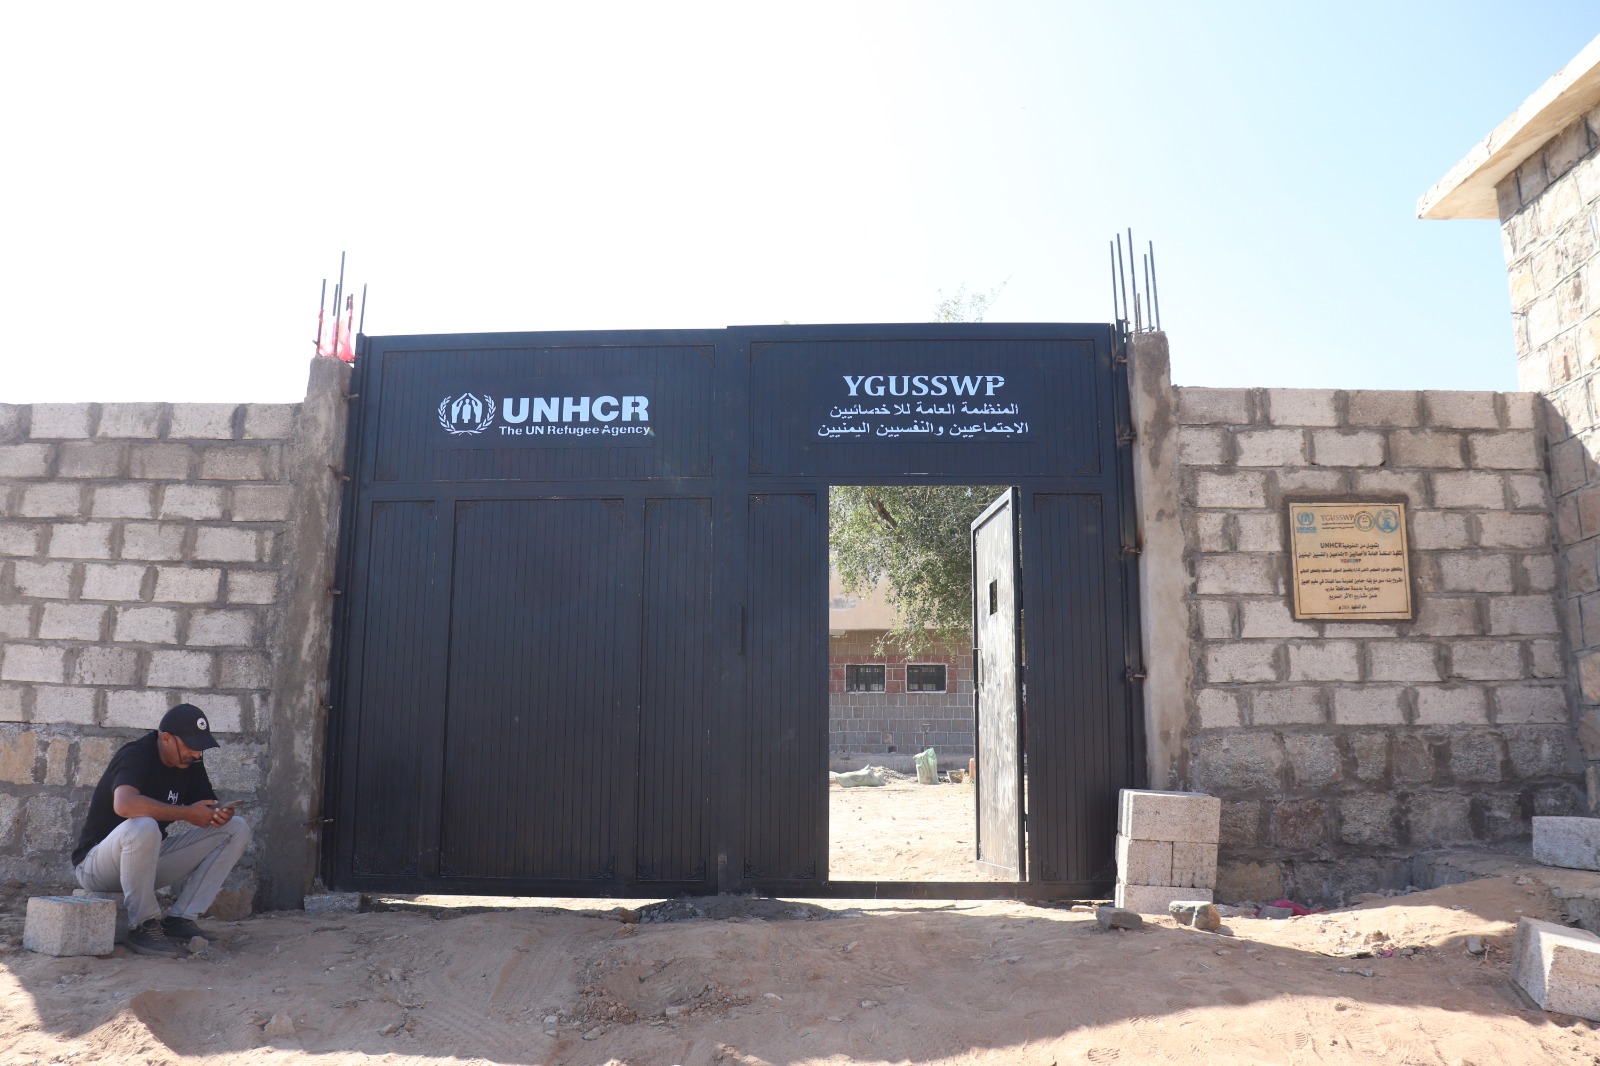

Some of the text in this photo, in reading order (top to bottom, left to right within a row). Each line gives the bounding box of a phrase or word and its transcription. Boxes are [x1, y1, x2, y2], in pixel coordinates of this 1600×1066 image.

[843, 375, 1005, 397] YGUSSWP
[502, 395, 649, 423] UNHCR
[916, 401, 955, 415] العامة
[961, 401, 1019, 415] المنظمة
[499, 424, 650, 437] The UN Refugee Agency
[818, 422, 870, 438] اليمنيين
[949, 422, 1029, 438] الاجتماعيين
